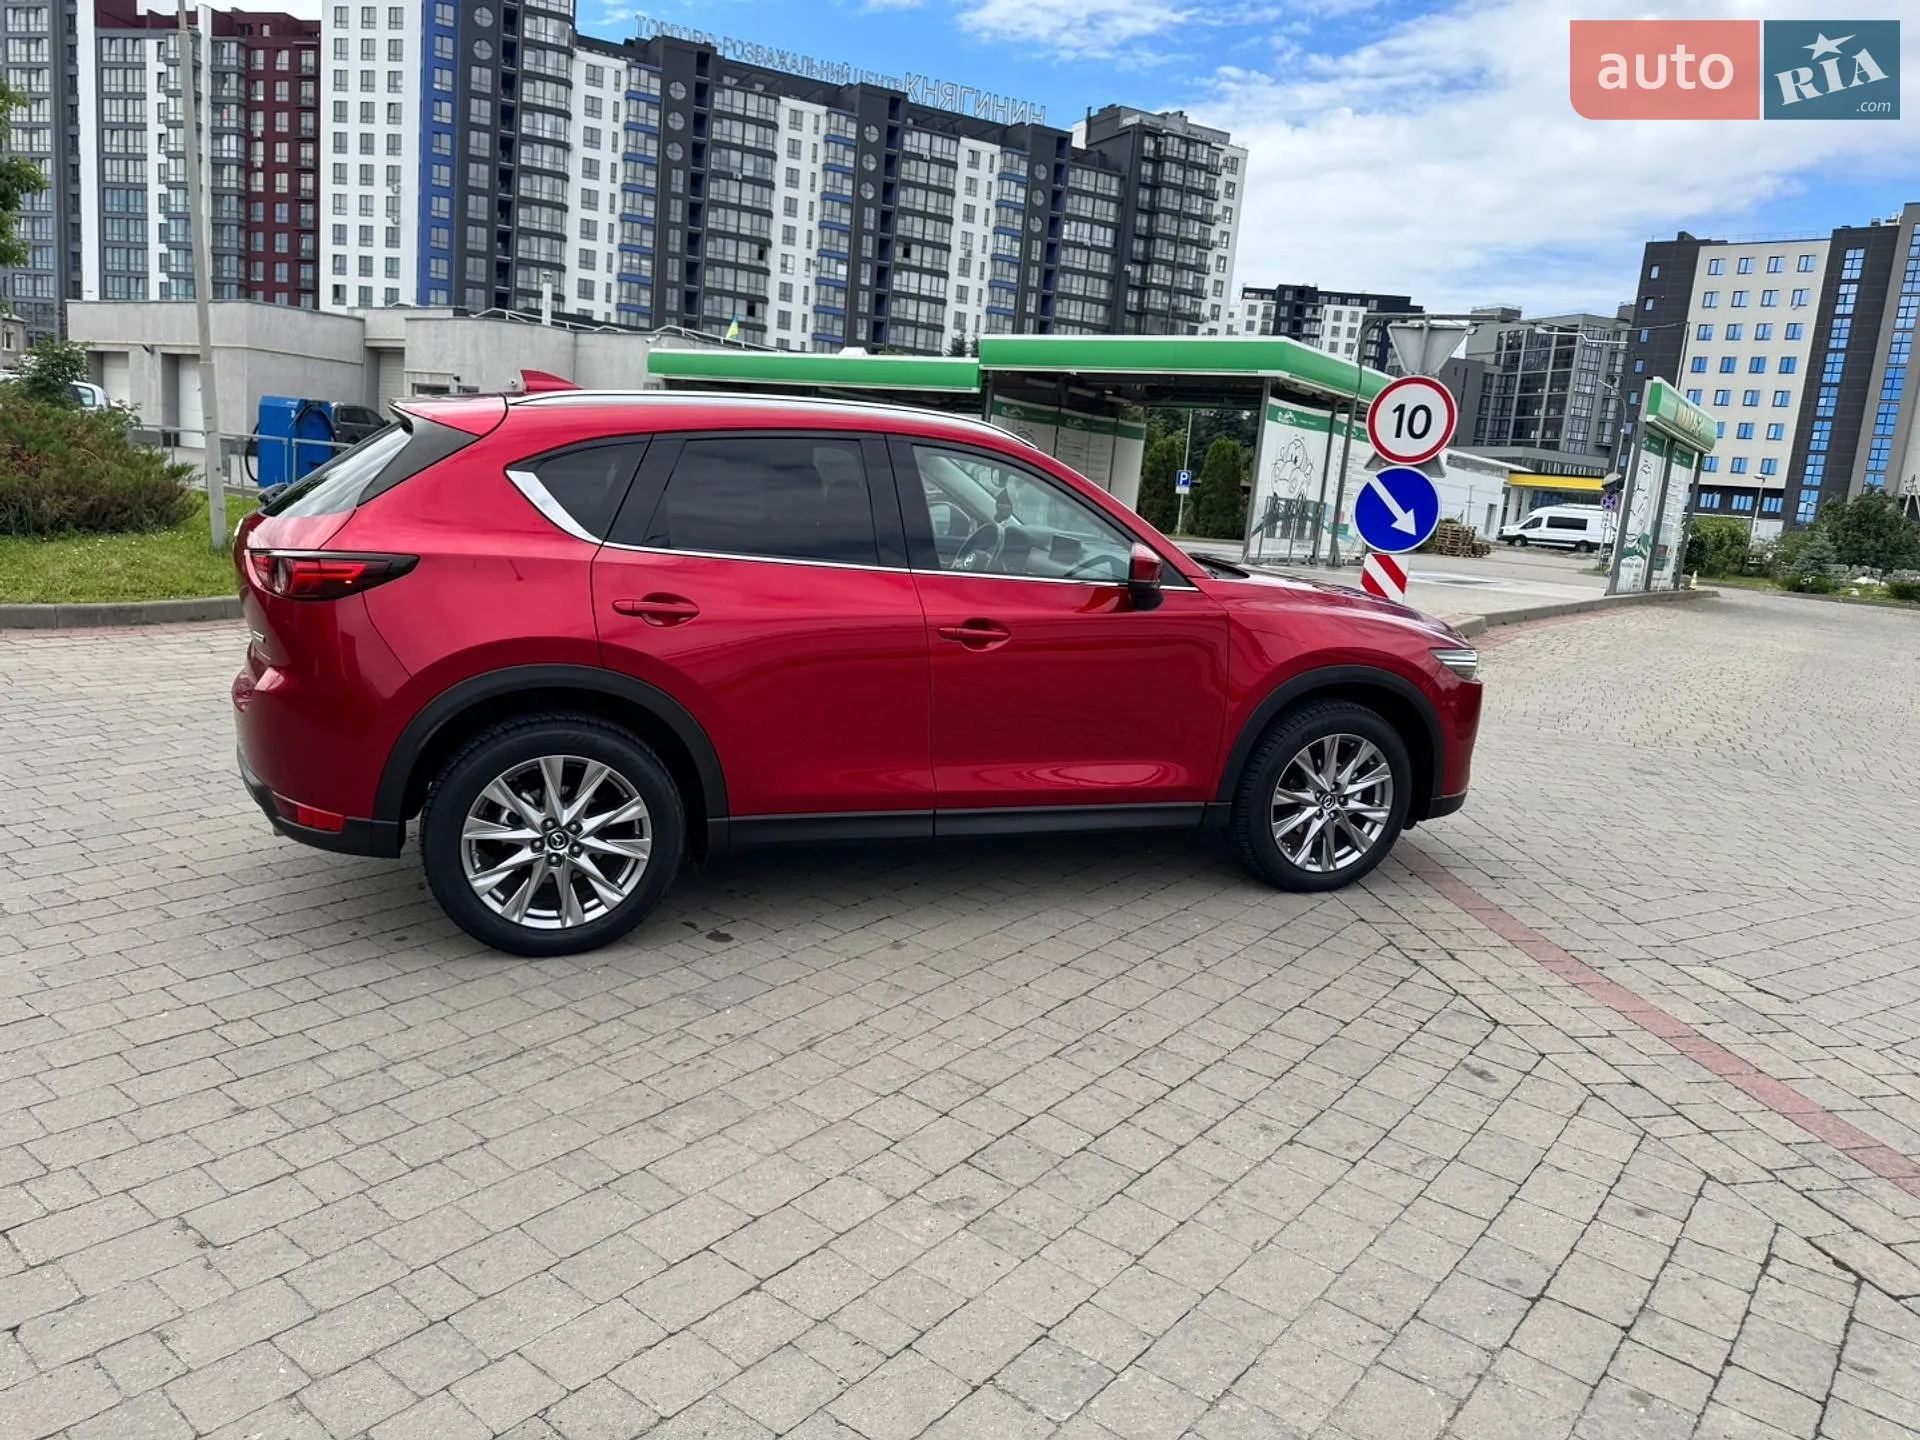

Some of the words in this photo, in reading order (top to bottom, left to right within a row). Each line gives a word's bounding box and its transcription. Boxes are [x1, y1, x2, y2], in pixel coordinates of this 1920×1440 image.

[905, 72, 1047, 126] КНЯГИНИН
[1392, 403, 1432, 439] 10
[1179, 471, 1188, 485] P
